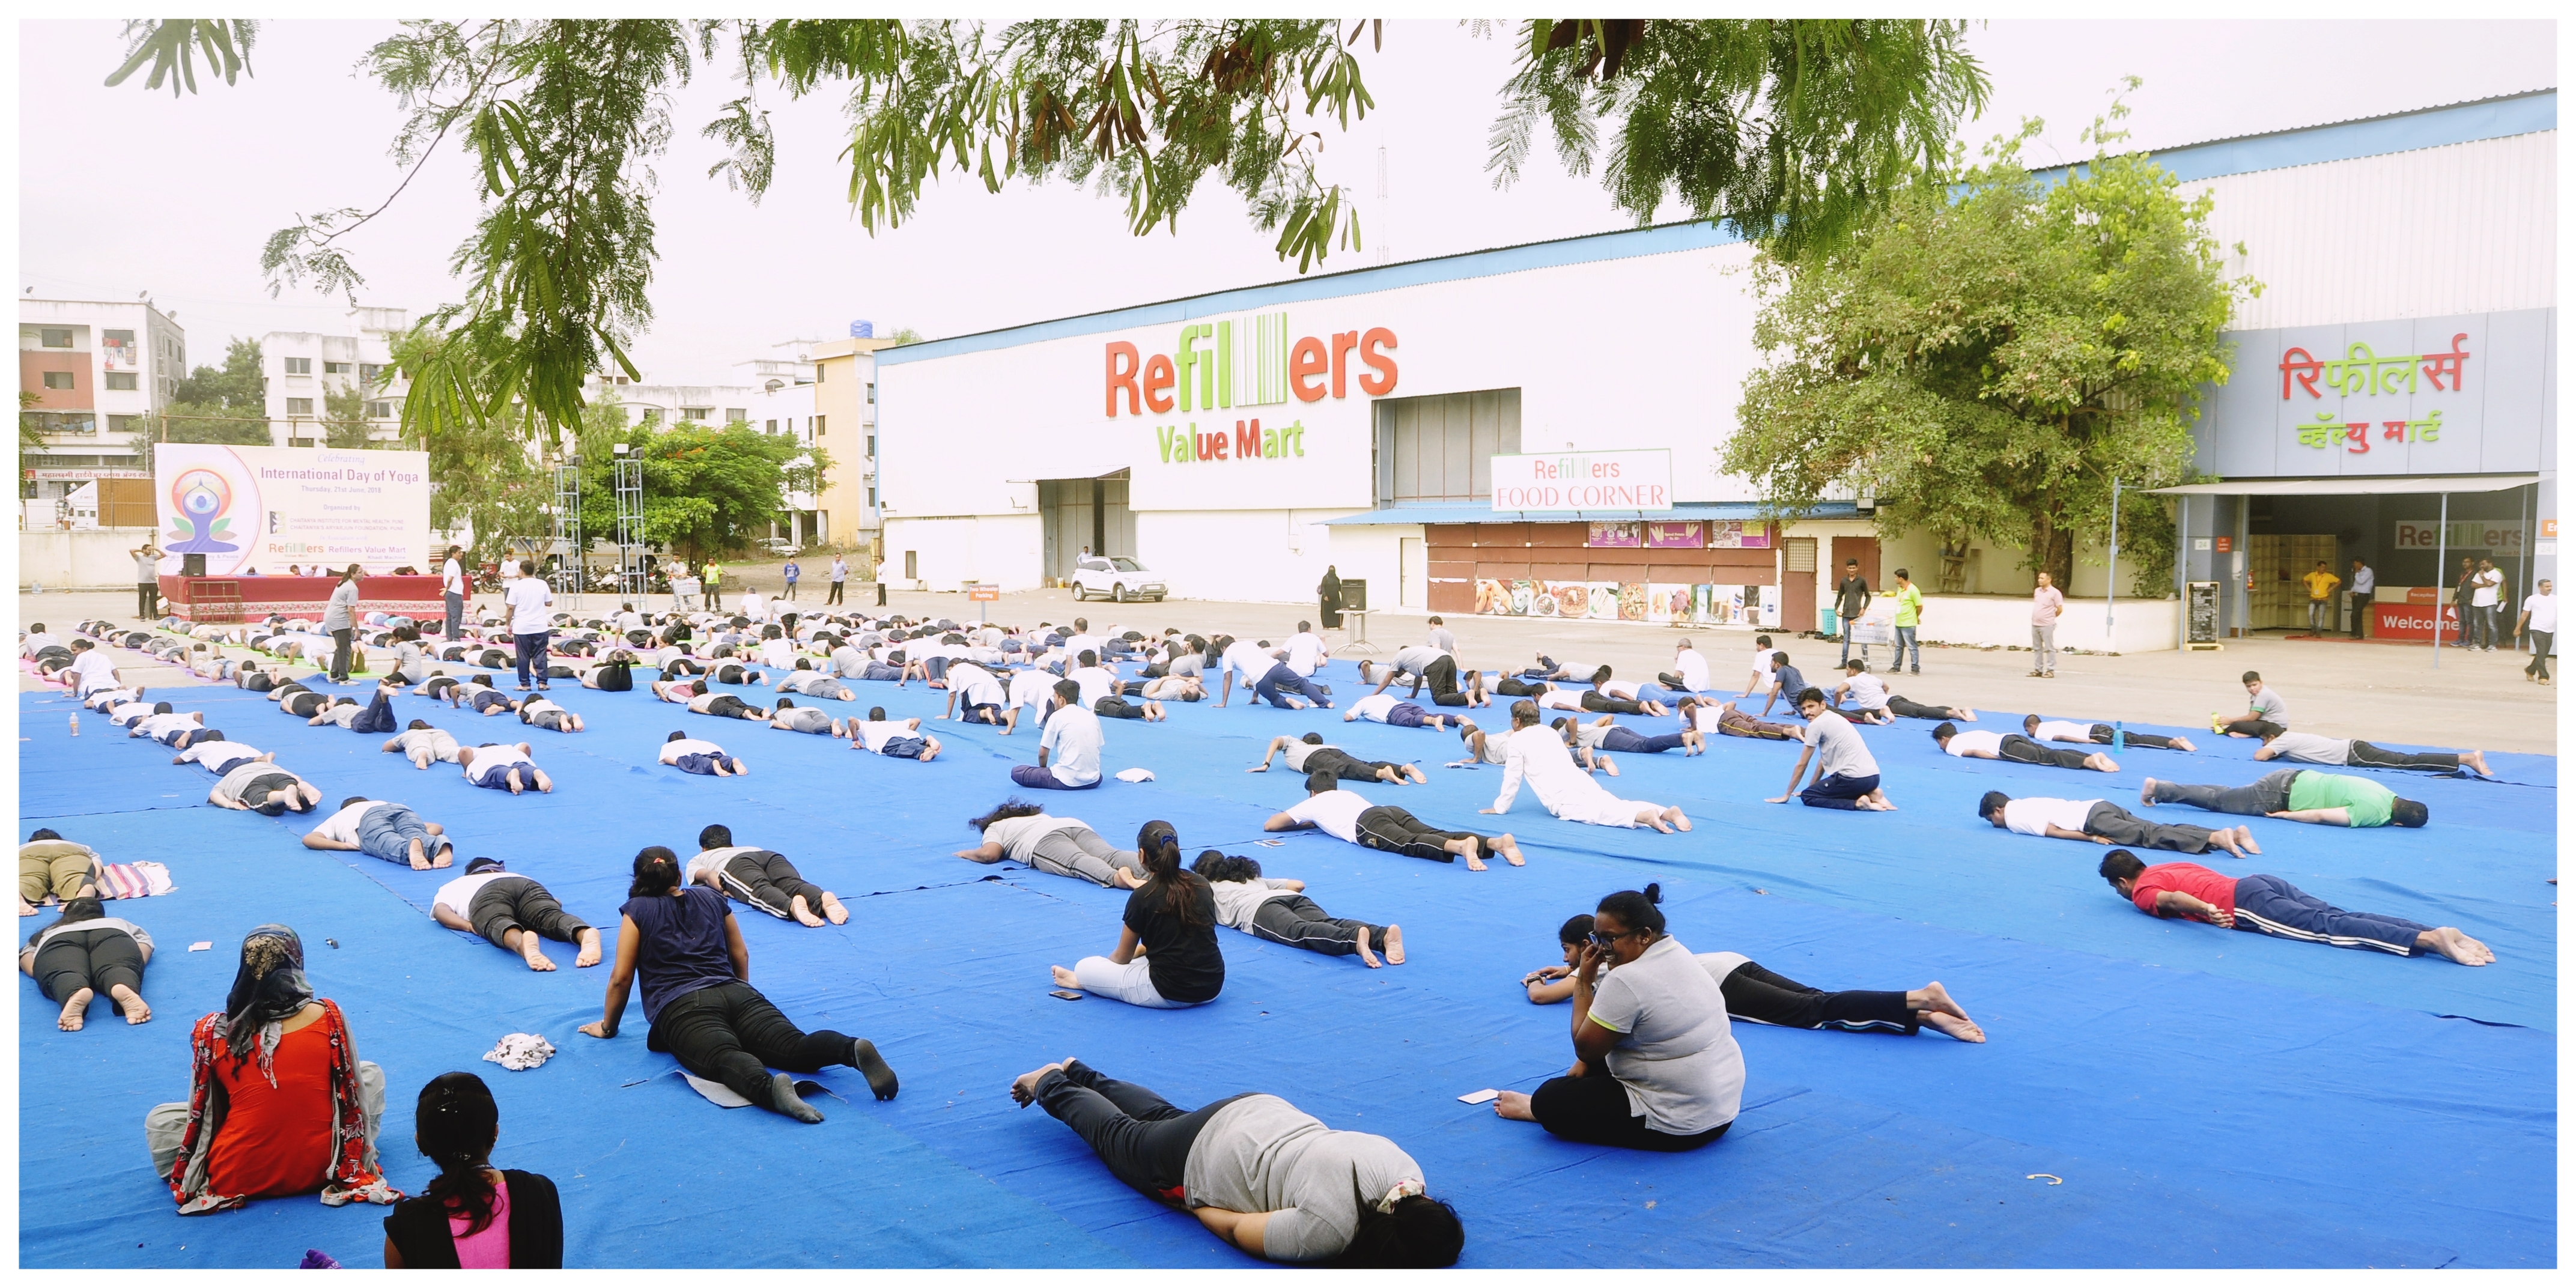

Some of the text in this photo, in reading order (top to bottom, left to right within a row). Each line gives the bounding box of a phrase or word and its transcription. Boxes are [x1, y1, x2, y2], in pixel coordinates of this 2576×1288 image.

[1105, 311, 1398, 417] Refillers
[2279, 333, 2470, 400] रिफीलर्स
[2383, 410, 2442, 443] मार्ट
[1156, 418, 1304, 462] Value Mart
[318, 453, 365, 466] Celebrating
[1535, 457, 1620, 479] Refillers
[261, 467, 419, 484] International Day of Yoga
[1498, 485, 1664, 507] FOOD CORNER
[2383, 615, 2459, 631] Welcome
